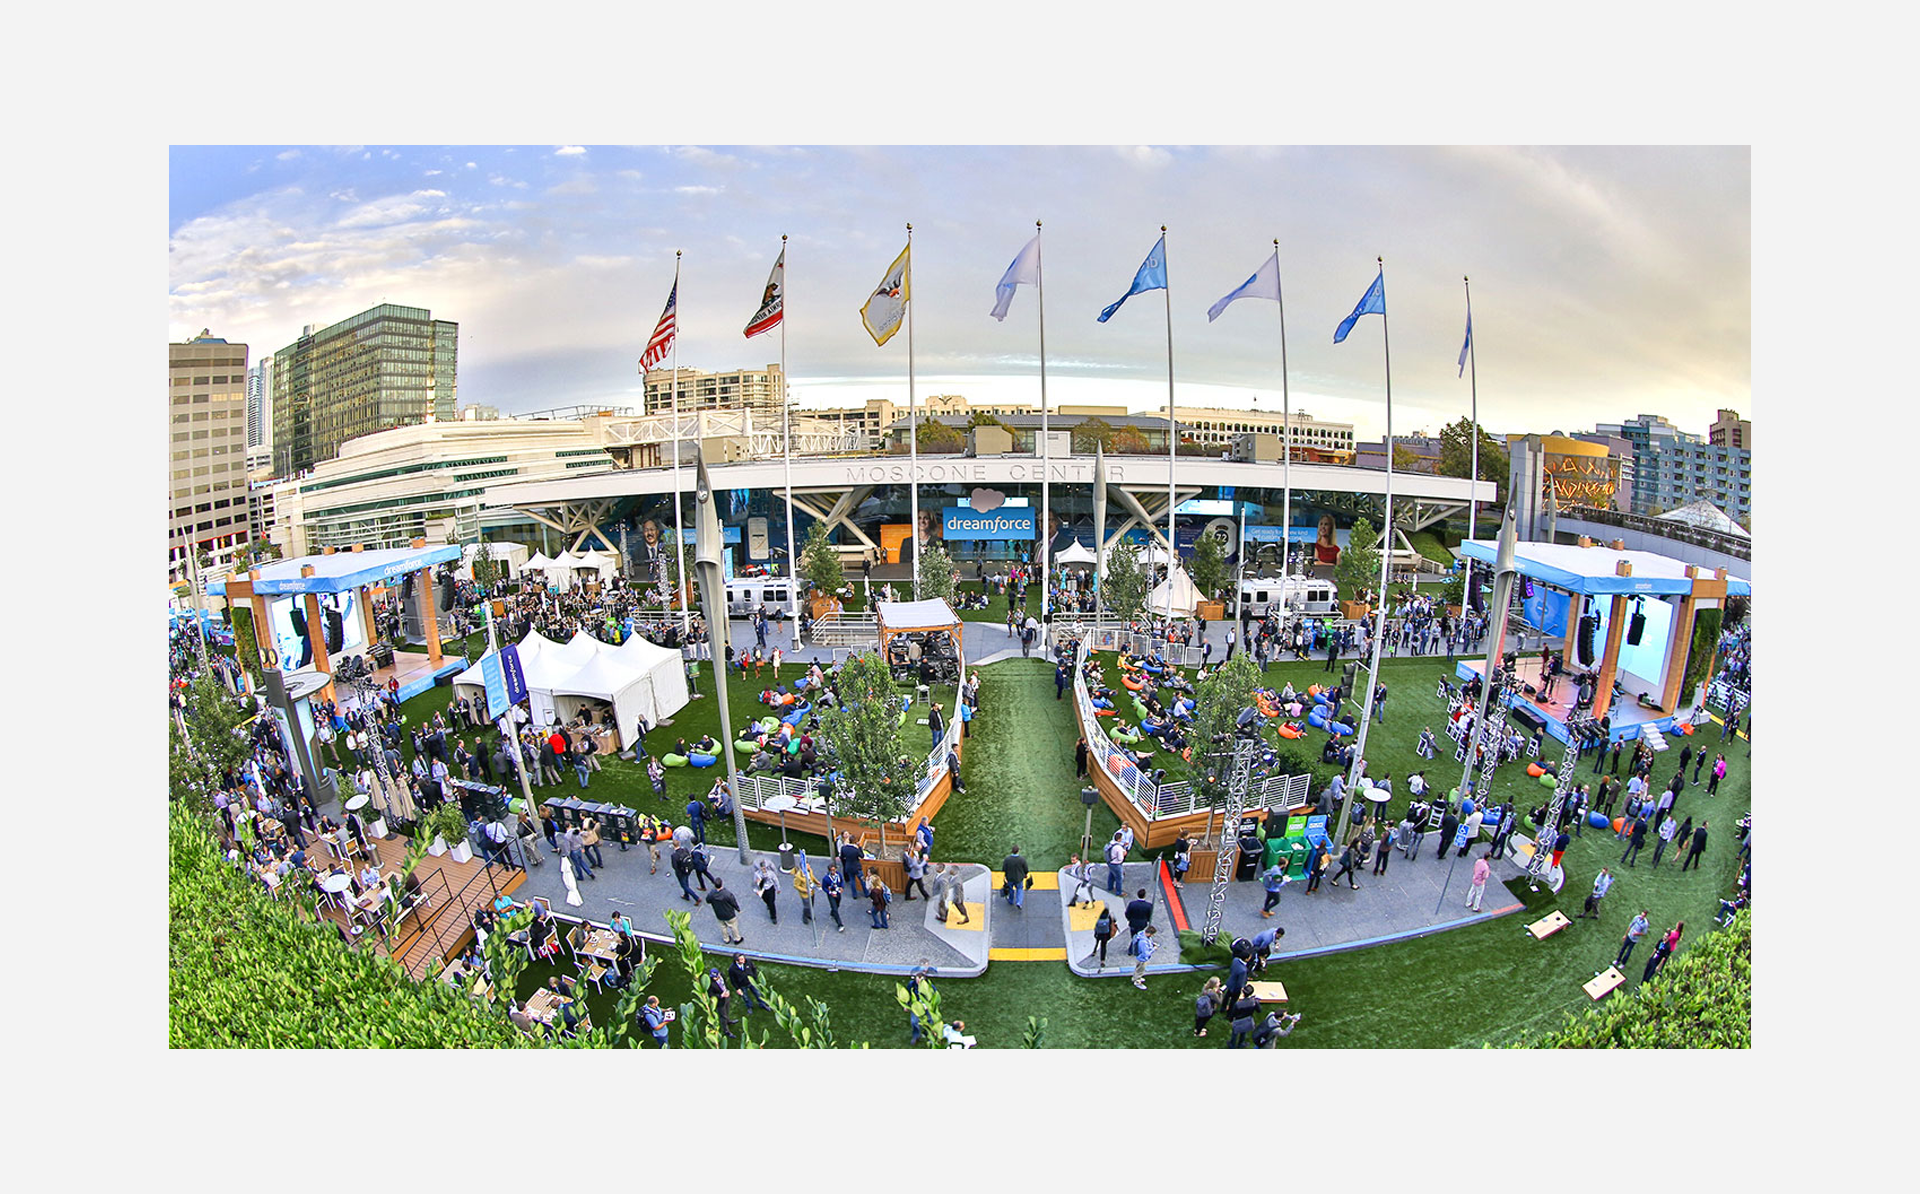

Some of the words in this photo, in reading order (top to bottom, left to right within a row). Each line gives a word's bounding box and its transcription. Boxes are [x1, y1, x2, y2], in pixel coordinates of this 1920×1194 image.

[847, 465, 987, 482] MOSCONE
[947, 515, 1032, 534] dreamforce
[383, 558, 423, 577] dreamforce
